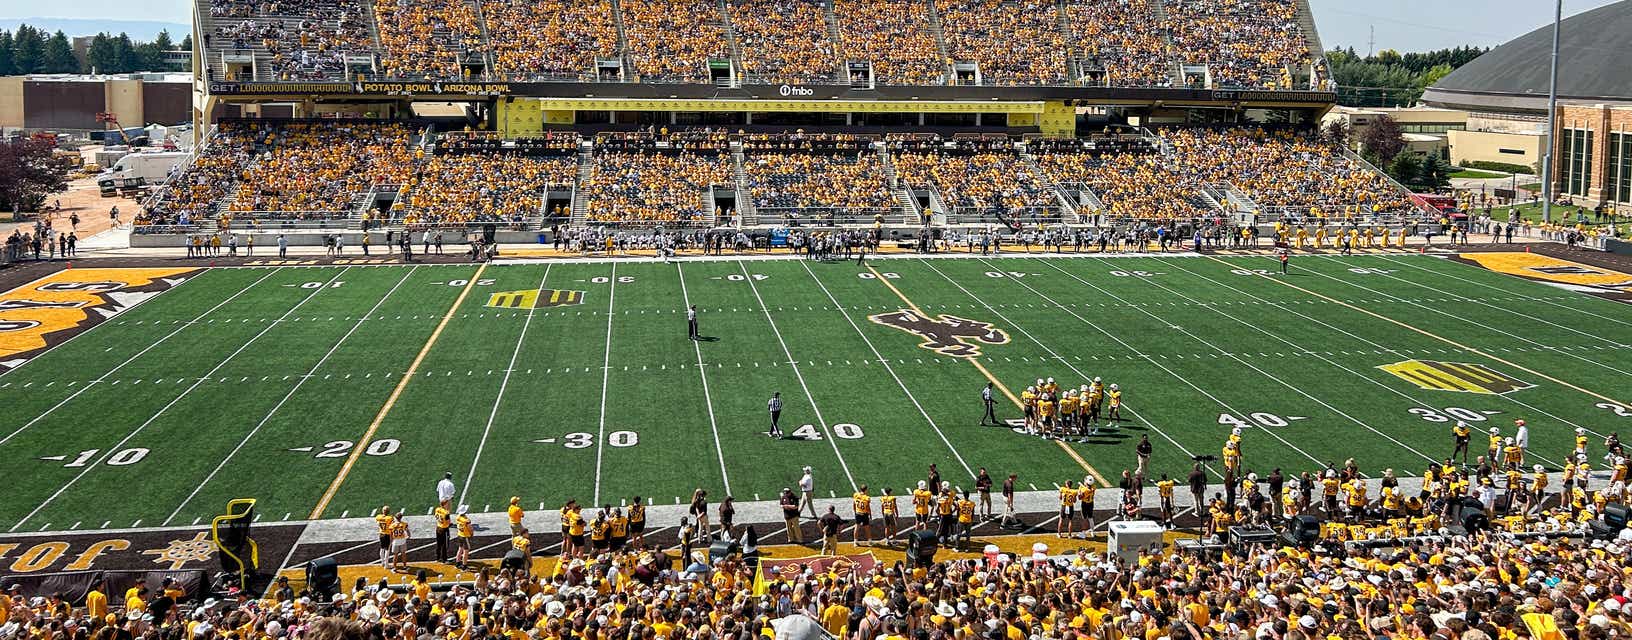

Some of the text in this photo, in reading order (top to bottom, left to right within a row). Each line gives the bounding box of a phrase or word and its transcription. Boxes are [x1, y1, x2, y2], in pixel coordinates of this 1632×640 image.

[364, 84, 432, 92] POTATO BOWL
[485, 85, 511, 93] BOWL
[792, 86, 813, 96] fnbo
[447, 278, 497, 287] 20
[591, 276, 635, 284] 30
[1407, 407, 1488, 423] 30
[1595, 402, 1632, 418] 2
[1217, 412, 1289, 428] 40
[563, 430, 640, 449] 30
[791, 423, 865, 441] 40
[314, 438, 402, 459] 20
[63, 447, 151, 468] 10
